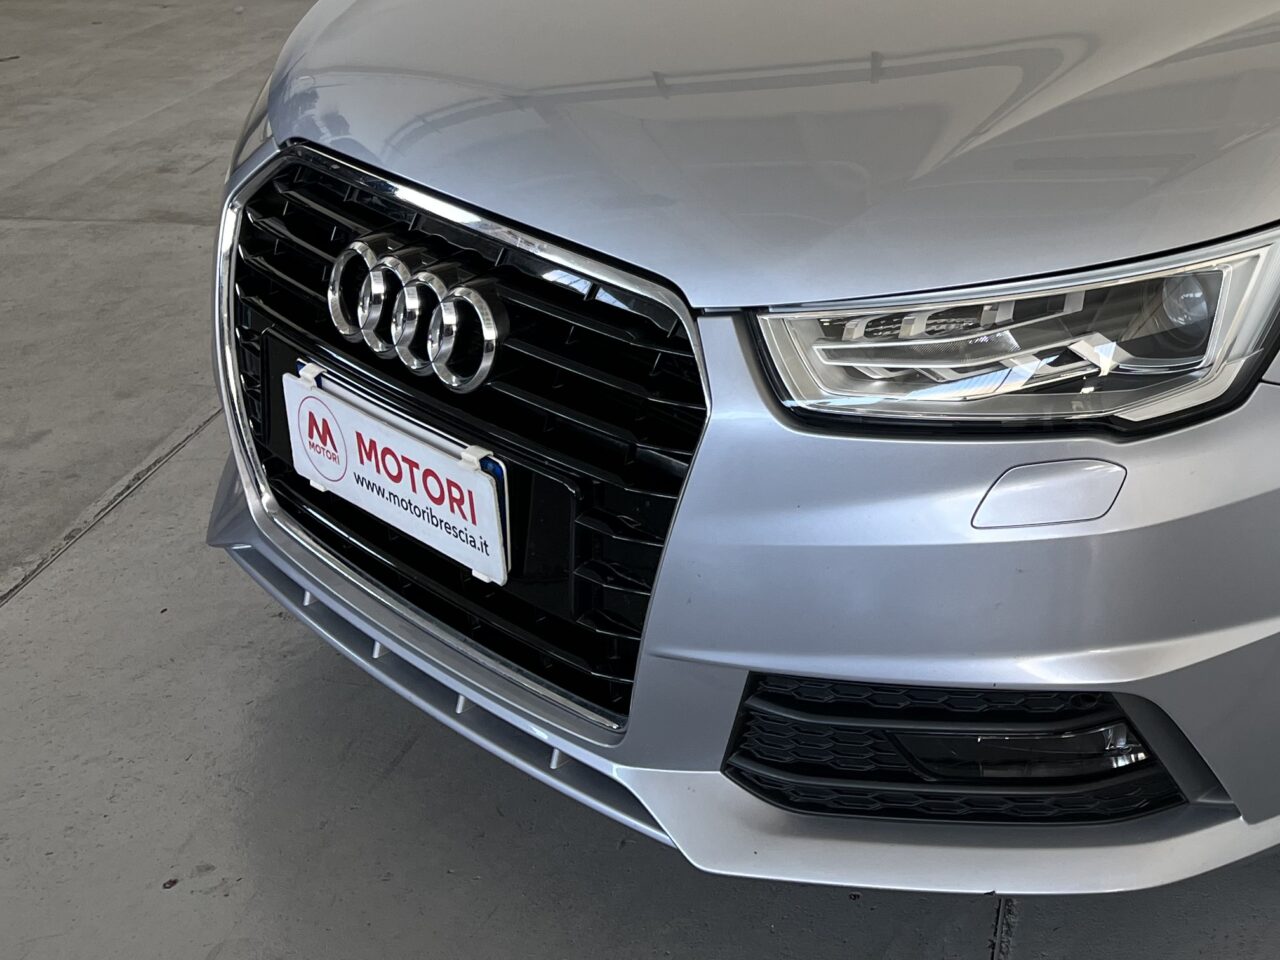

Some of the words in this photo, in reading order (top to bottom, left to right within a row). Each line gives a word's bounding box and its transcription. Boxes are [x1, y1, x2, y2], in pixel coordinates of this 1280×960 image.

[308, 410, 338, 453] M
[308, 440, 340, 465] MOTORI
[355, 431, 477, 526] MOTORI
[353, 472, 490, 557] www.motoribrescia.it
